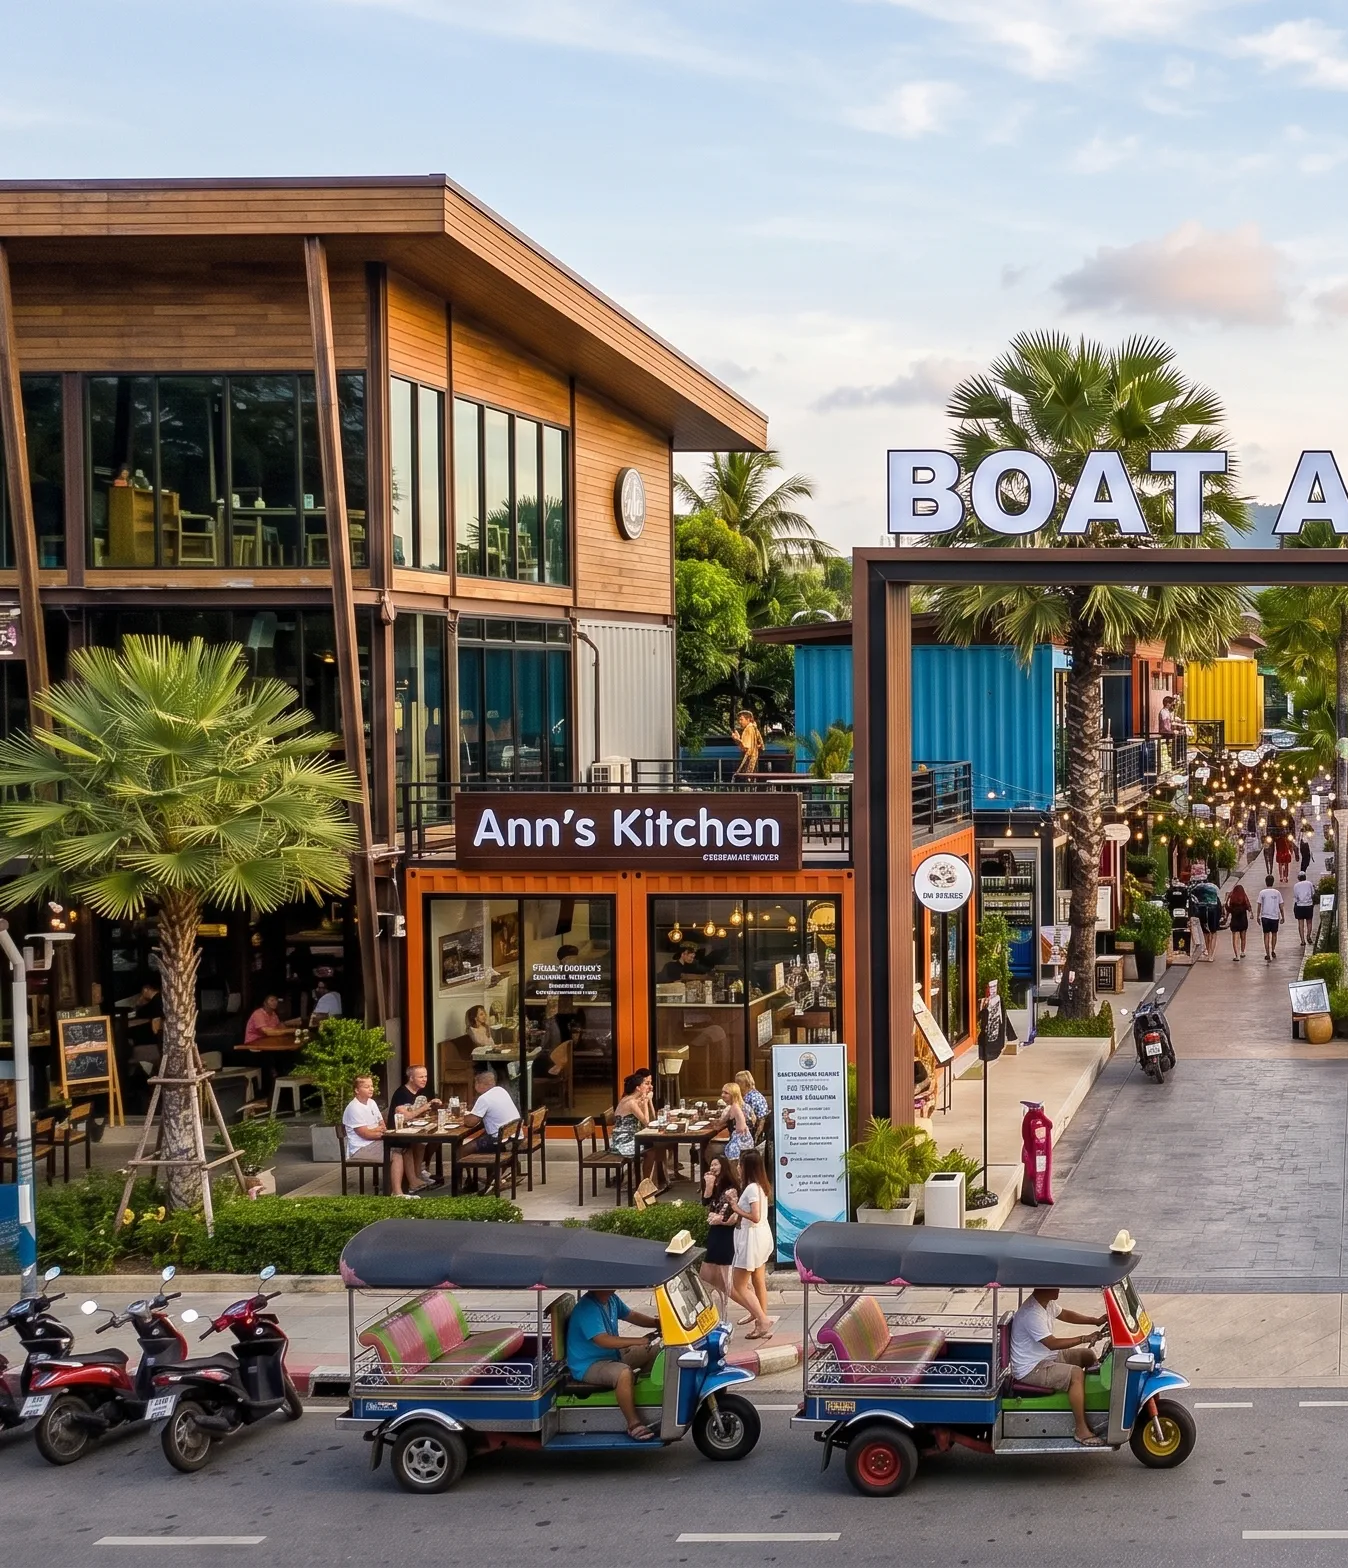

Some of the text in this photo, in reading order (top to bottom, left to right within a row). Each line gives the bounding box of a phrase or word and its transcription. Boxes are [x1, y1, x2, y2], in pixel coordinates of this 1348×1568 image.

[886, 449, 1229, 537] BOAT
[473, 807, 780, 848] Ann's Kitchen
